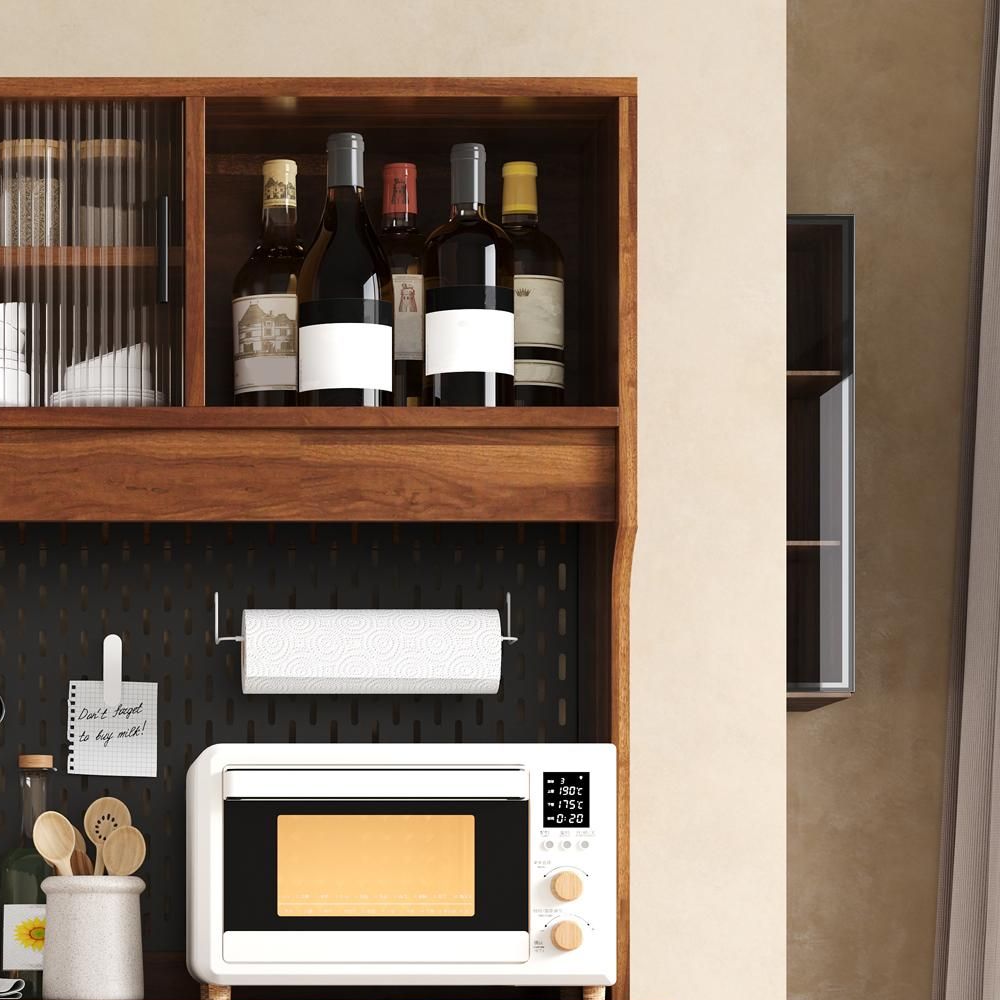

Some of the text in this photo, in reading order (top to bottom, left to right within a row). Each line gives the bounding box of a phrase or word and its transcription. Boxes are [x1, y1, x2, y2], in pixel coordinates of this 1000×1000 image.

[78, 702, 143, 720] Don't forget
[79, 720, 146, 747] to buy milk!
[556, 813, 583, 823] 0:20
